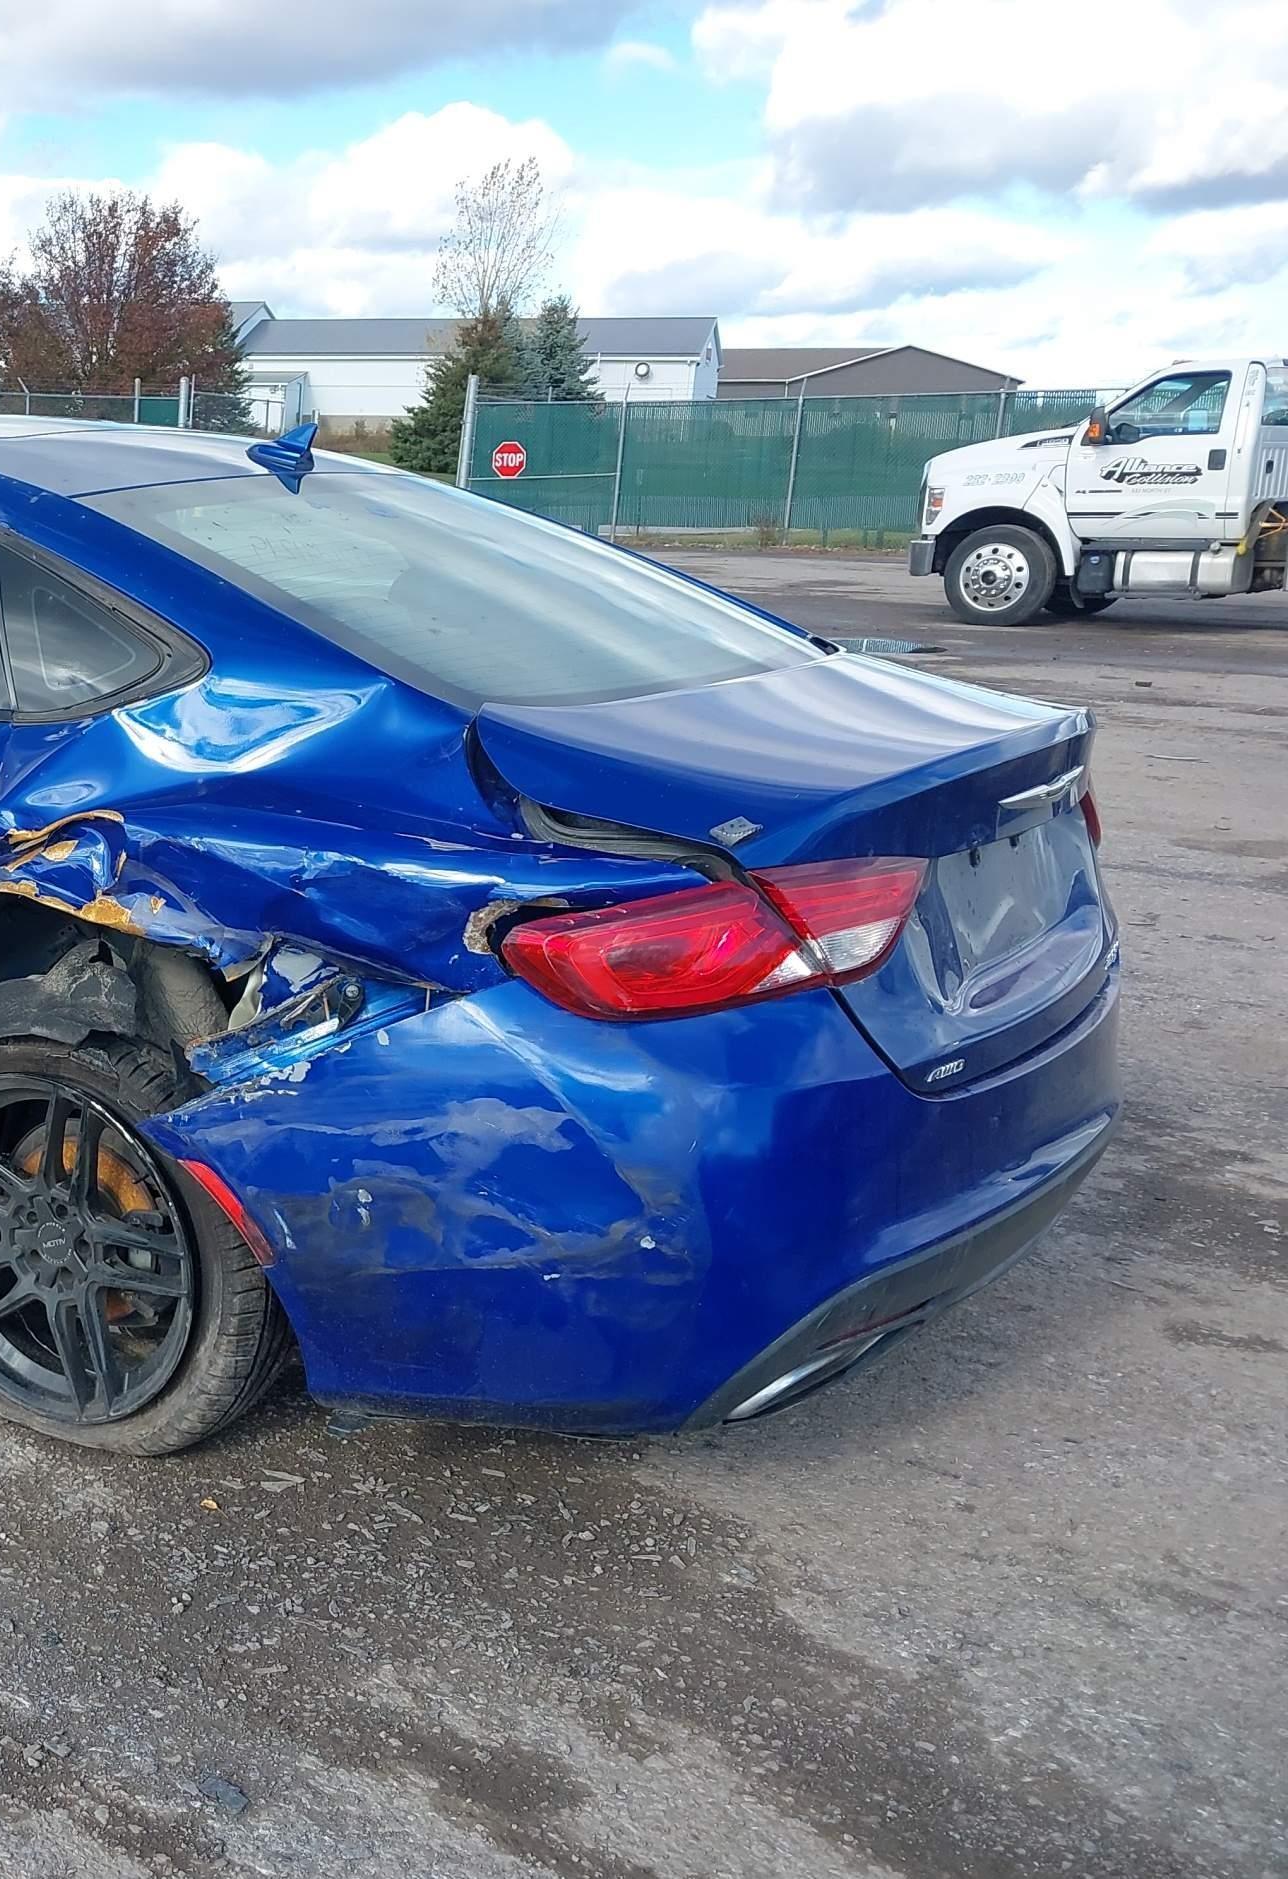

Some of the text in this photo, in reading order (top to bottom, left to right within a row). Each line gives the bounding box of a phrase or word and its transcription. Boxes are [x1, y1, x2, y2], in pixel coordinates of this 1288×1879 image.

[495, 453, 524, 467] STOP
[1100, 456, 1202, 481] Alliance
[1126, 473, 1199, 485] Collision
[927, 1058, 966, 1083] AWD
